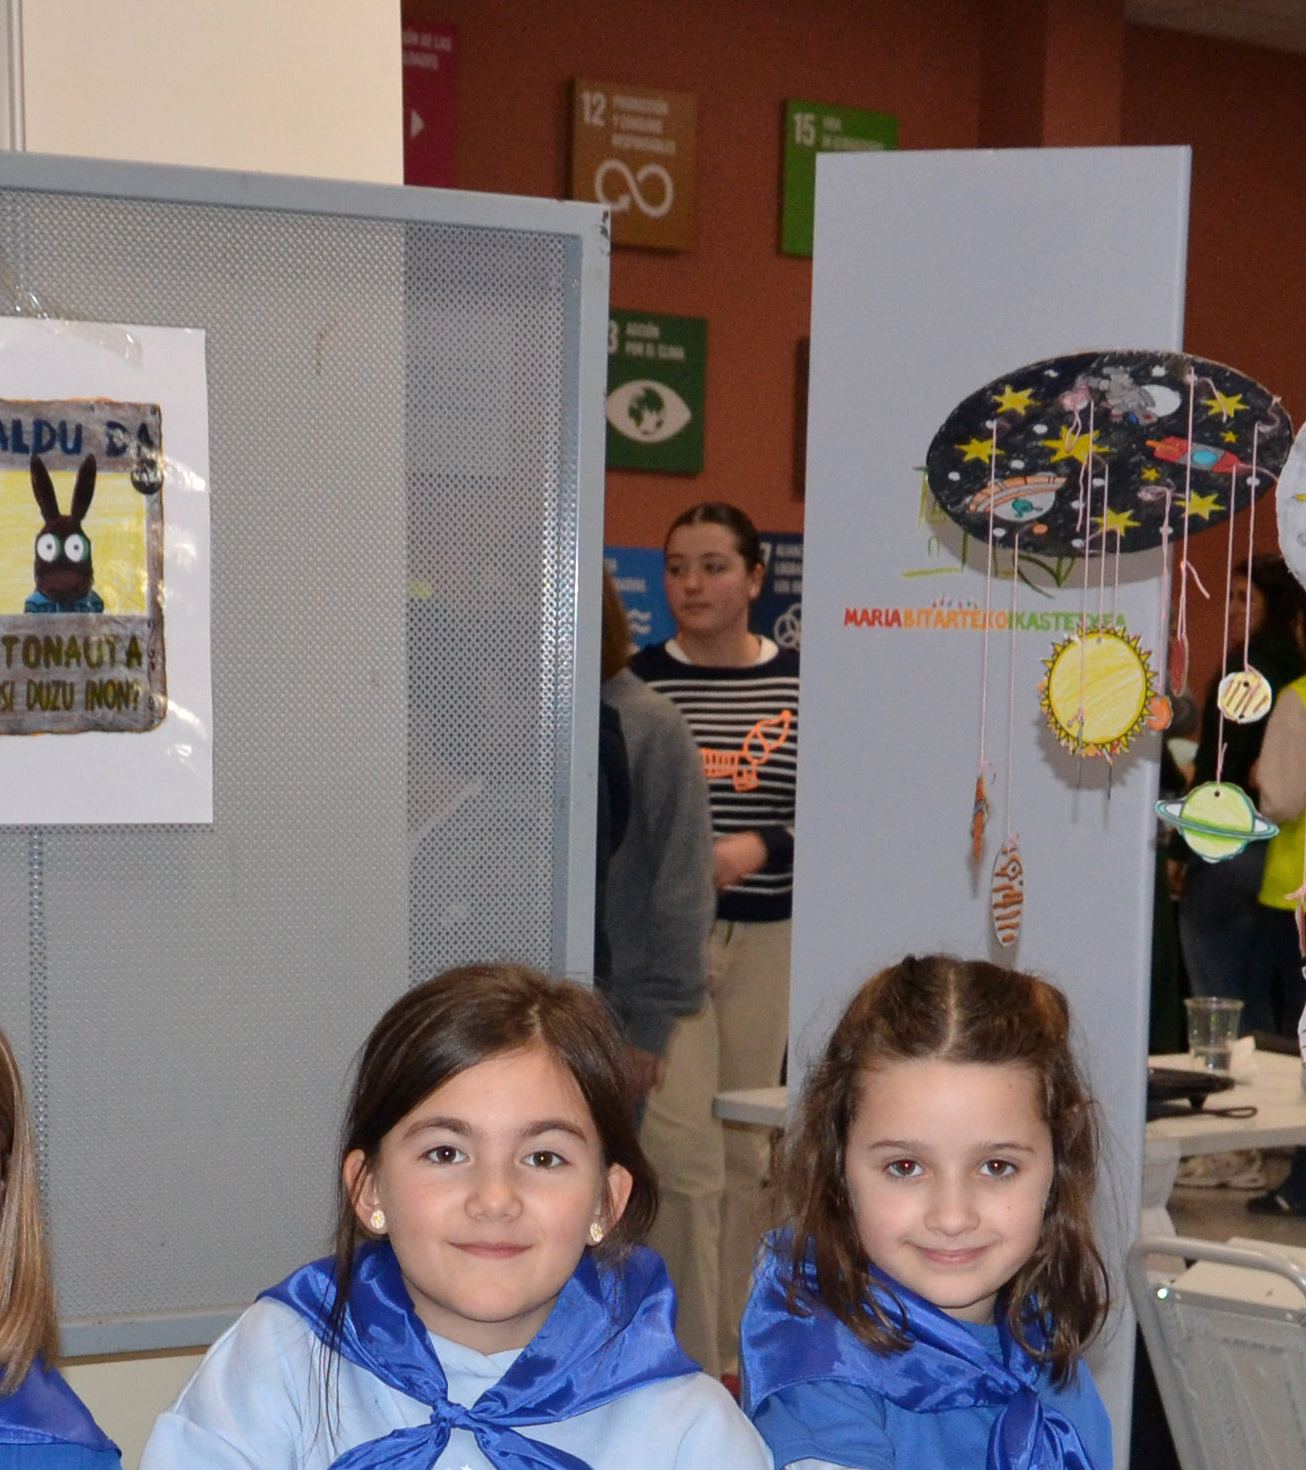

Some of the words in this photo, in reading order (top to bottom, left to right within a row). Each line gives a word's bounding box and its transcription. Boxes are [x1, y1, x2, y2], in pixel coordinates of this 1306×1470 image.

[581, 90, 607, 128] 12
[793, 112, 816, 147] 15
[26, 678, 75, 712] DUZU
